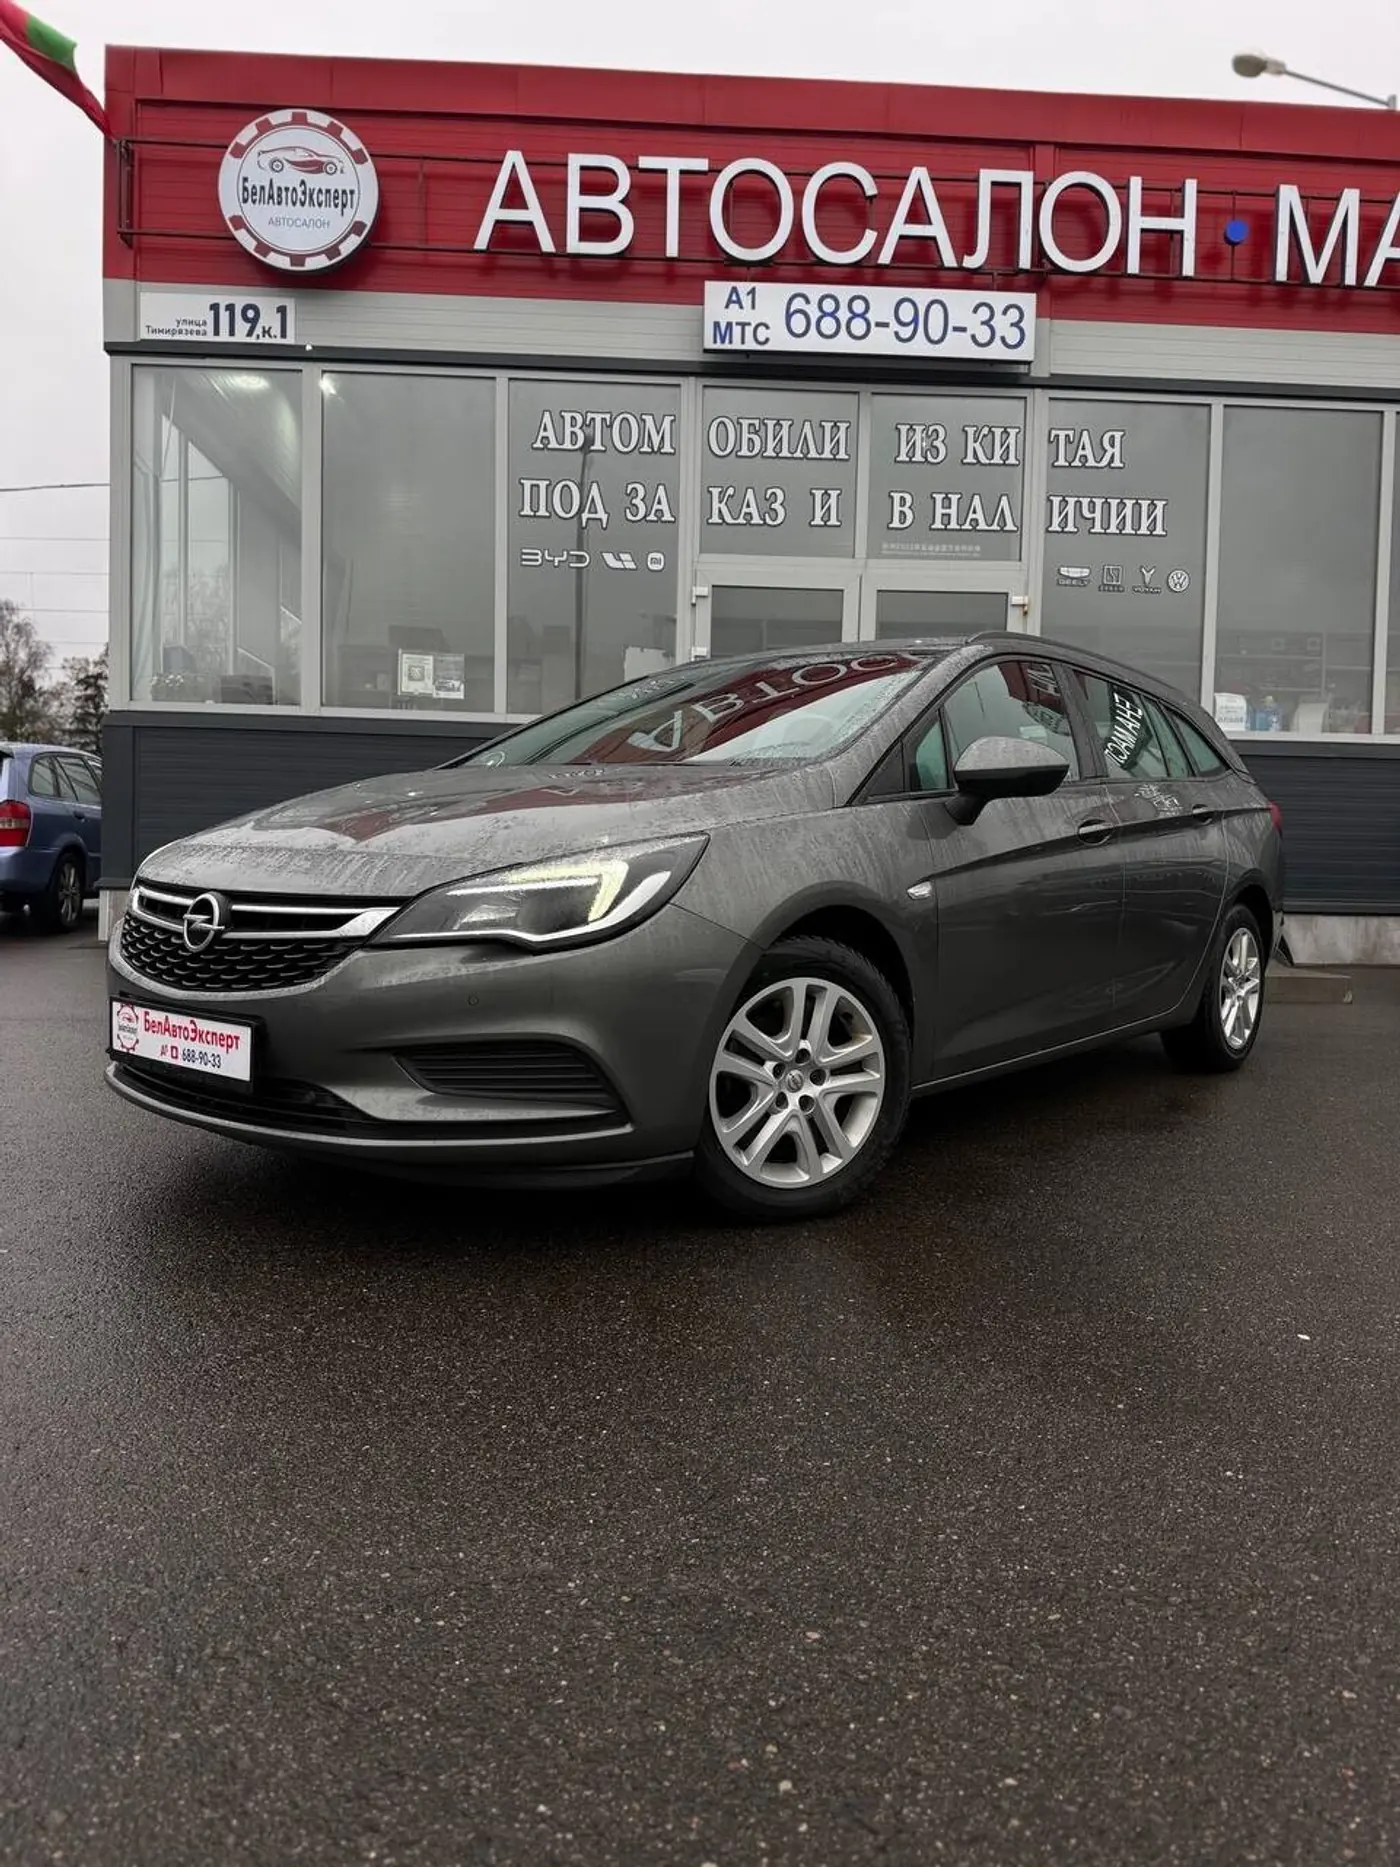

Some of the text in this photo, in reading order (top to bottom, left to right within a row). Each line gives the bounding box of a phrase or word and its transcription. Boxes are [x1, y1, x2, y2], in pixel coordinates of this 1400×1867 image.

[242, 177, 355, 216] БелАвтоЭксперт
[473, 150, 1197, 277] АВТОСАЛОН
[268, 216, 331, 229] АВТОСАЛОН
[145, 325, 208, 337] Тимирязева
[176, 318, 208, 328] улица
[785, 292, 1026, 350] 688-90-33
[532, 410, 1125, 468] АВТОМ ОБИЛИ ИЗ КИ ТАЯ
[519, 478, 1168, 536] ПОД ЗА КАЗ И В НАЛ ИЧИИ
[520, 548, 591, 568] BYD
[143, 1010, 240, 1054] БелАвтоЭксперт
[182, 1048, 221, 1069] 688-90-33
